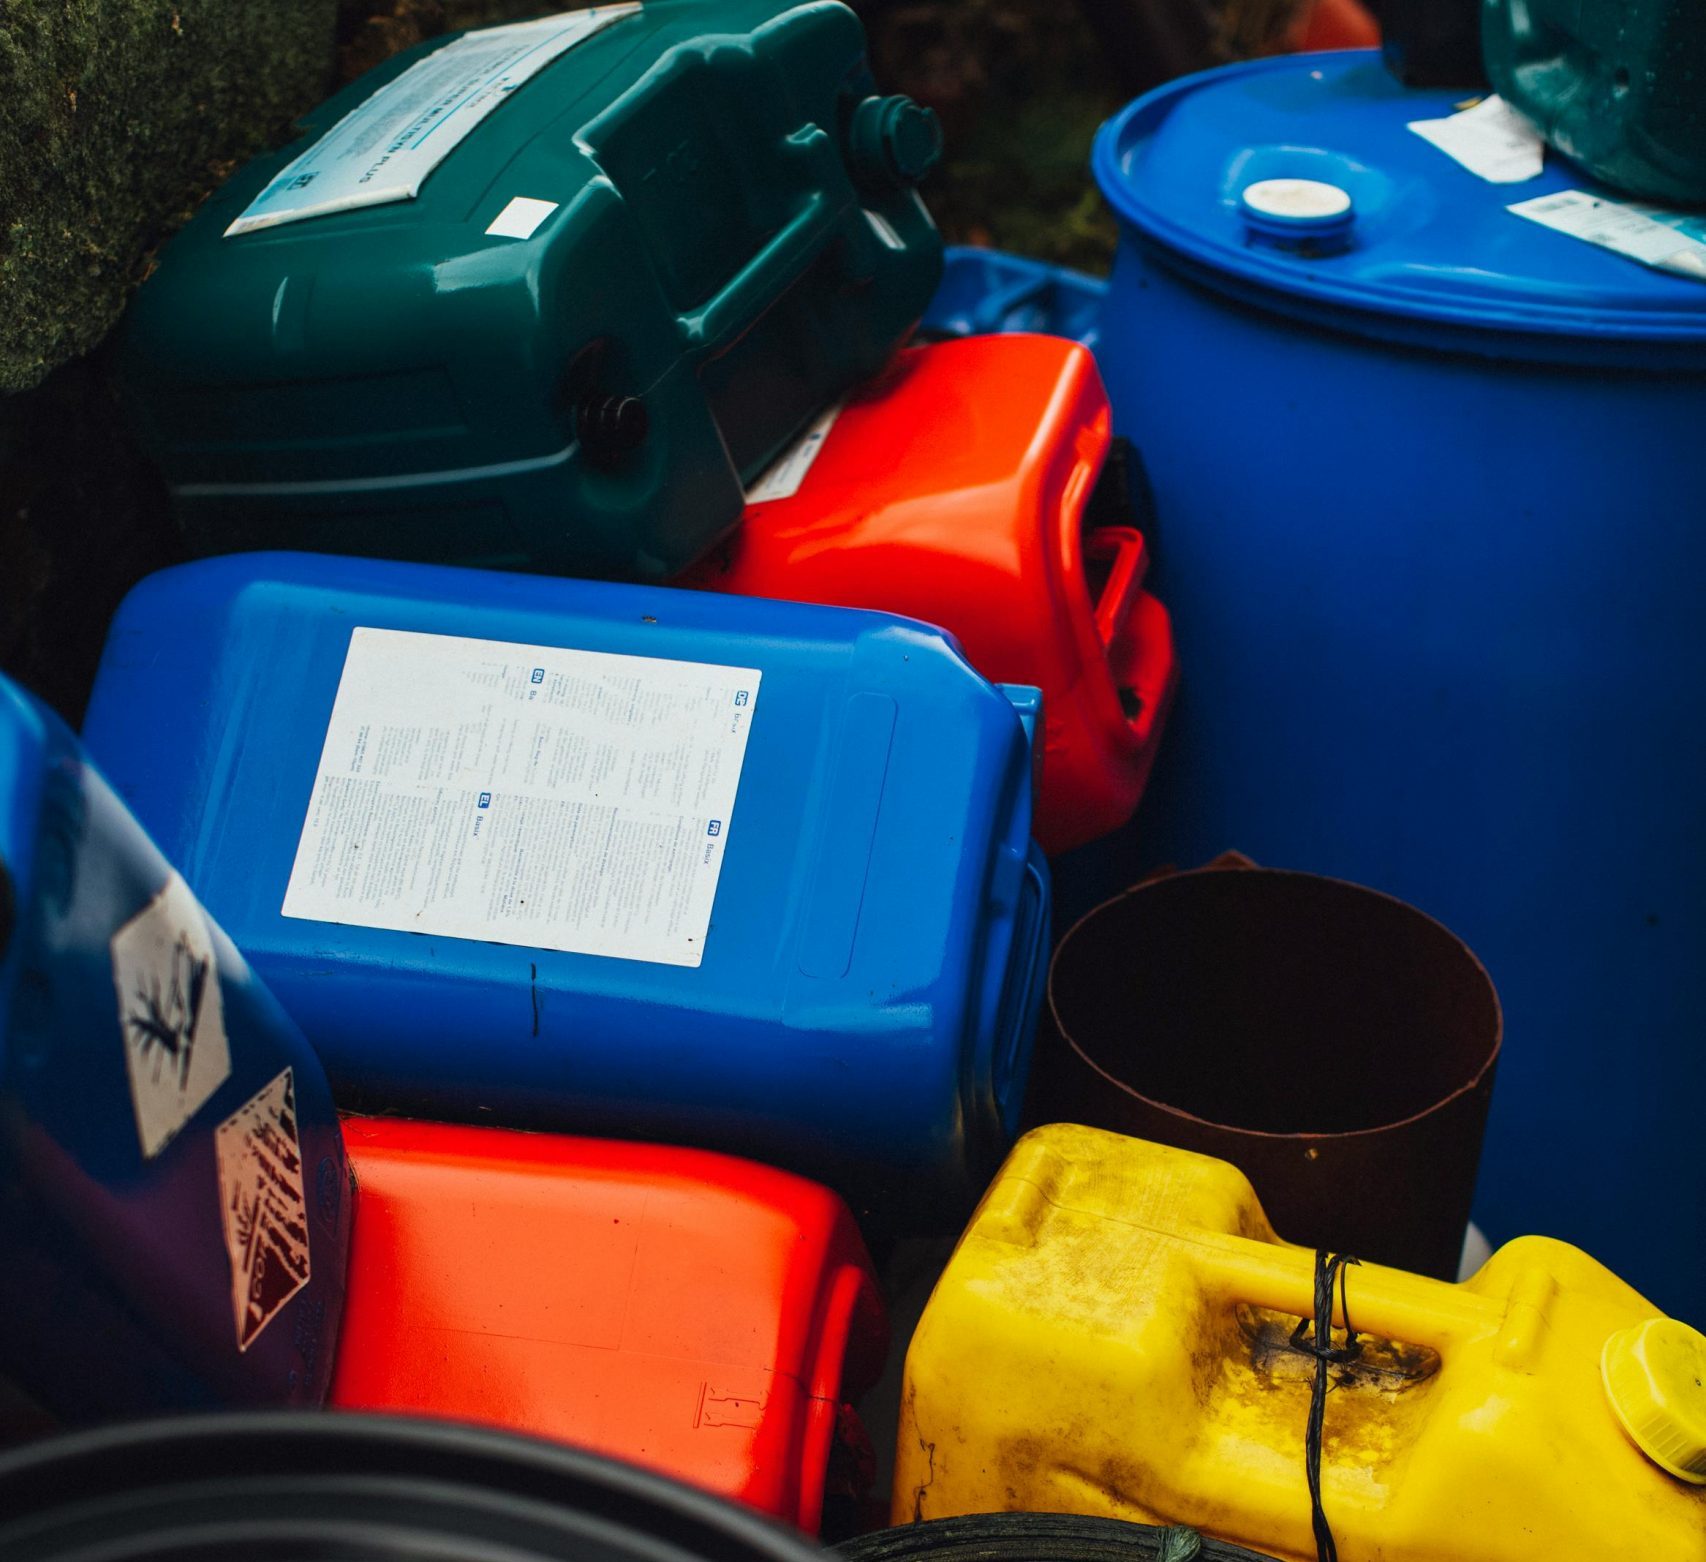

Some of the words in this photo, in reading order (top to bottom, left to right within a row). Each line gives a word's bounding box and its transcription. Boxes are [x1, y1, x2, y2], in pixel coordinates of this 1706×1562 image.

[358, 155, 390, 184] PLUS
[532, 669, 543, 683] EN
[479, 793, 490, 808] EL
[473, 815, 483, 836] Basix
[709, 820, 720, 835] FR
[703, 843, 714, 865] Basix
